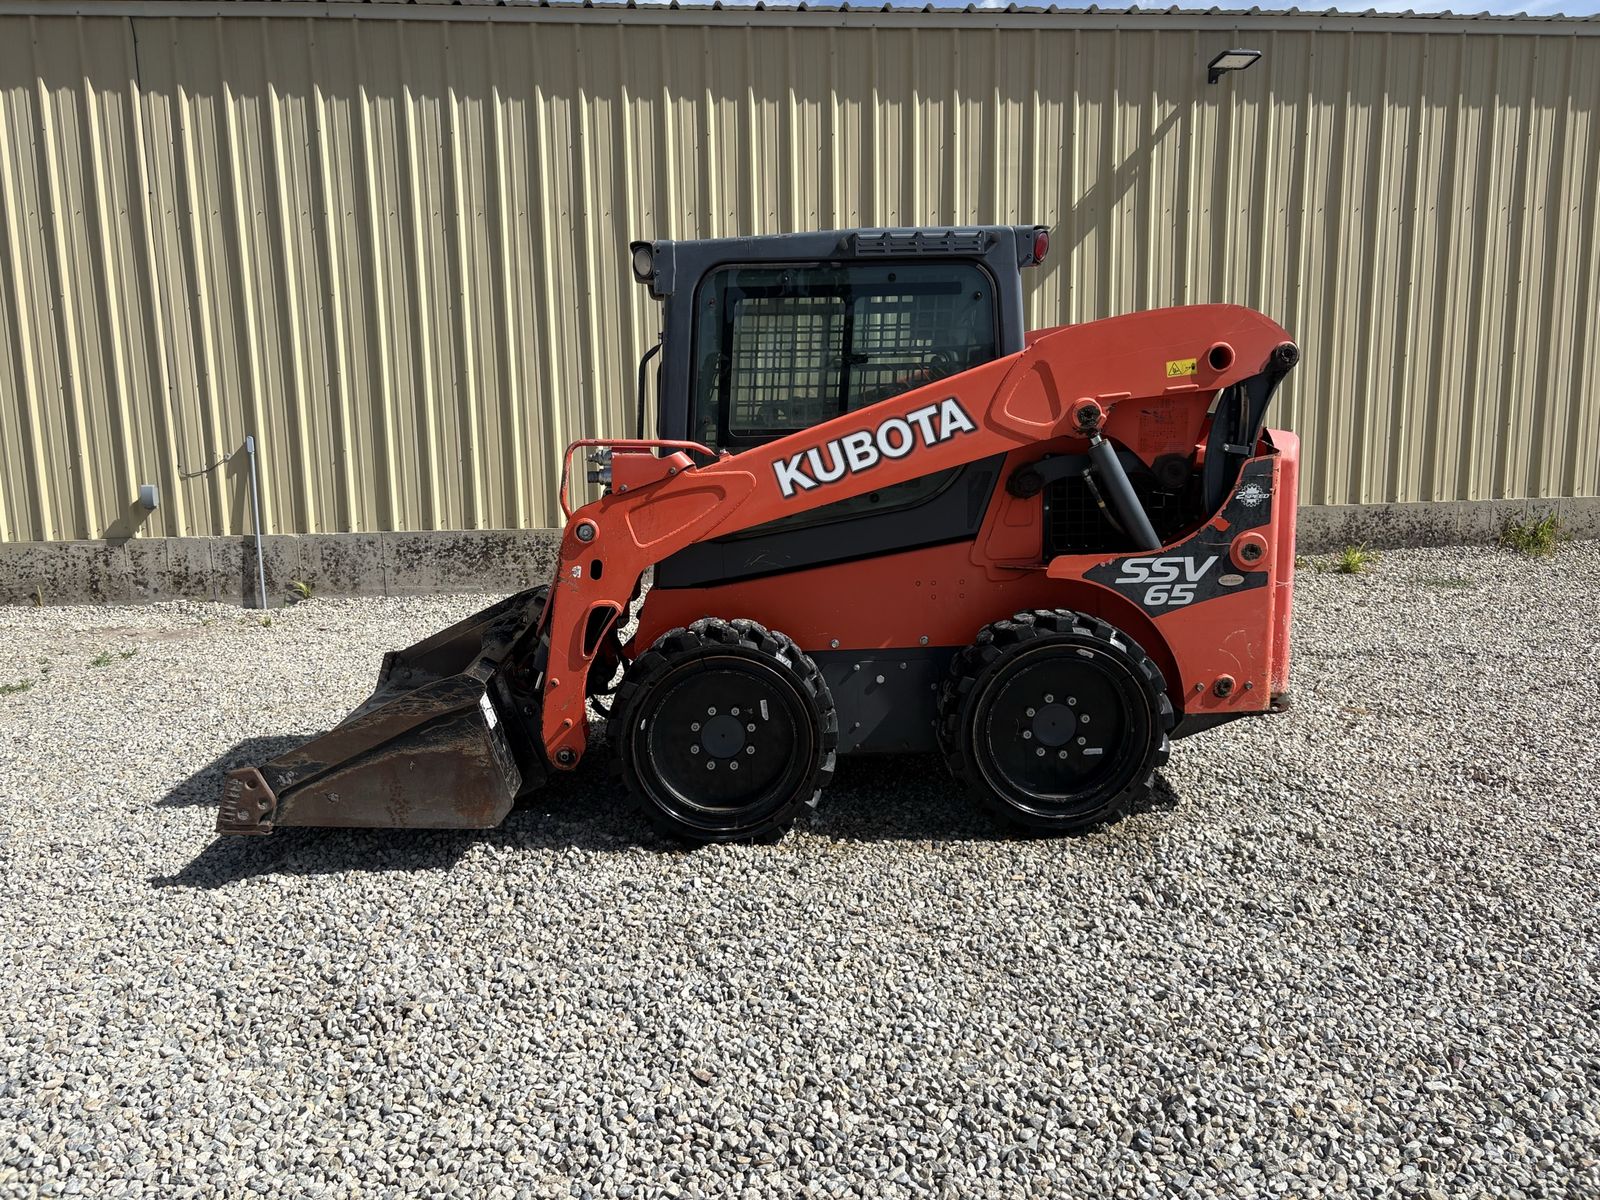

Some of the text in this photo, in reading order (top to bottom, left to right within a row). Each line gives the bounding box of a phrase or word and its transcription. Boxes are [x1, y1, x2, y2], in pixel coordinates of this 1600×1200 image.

[771, 397, 977, 498] KUBOTA
[1115, 555, 1219, 584] SSV
[1143, 583, 1198, 606] 65
